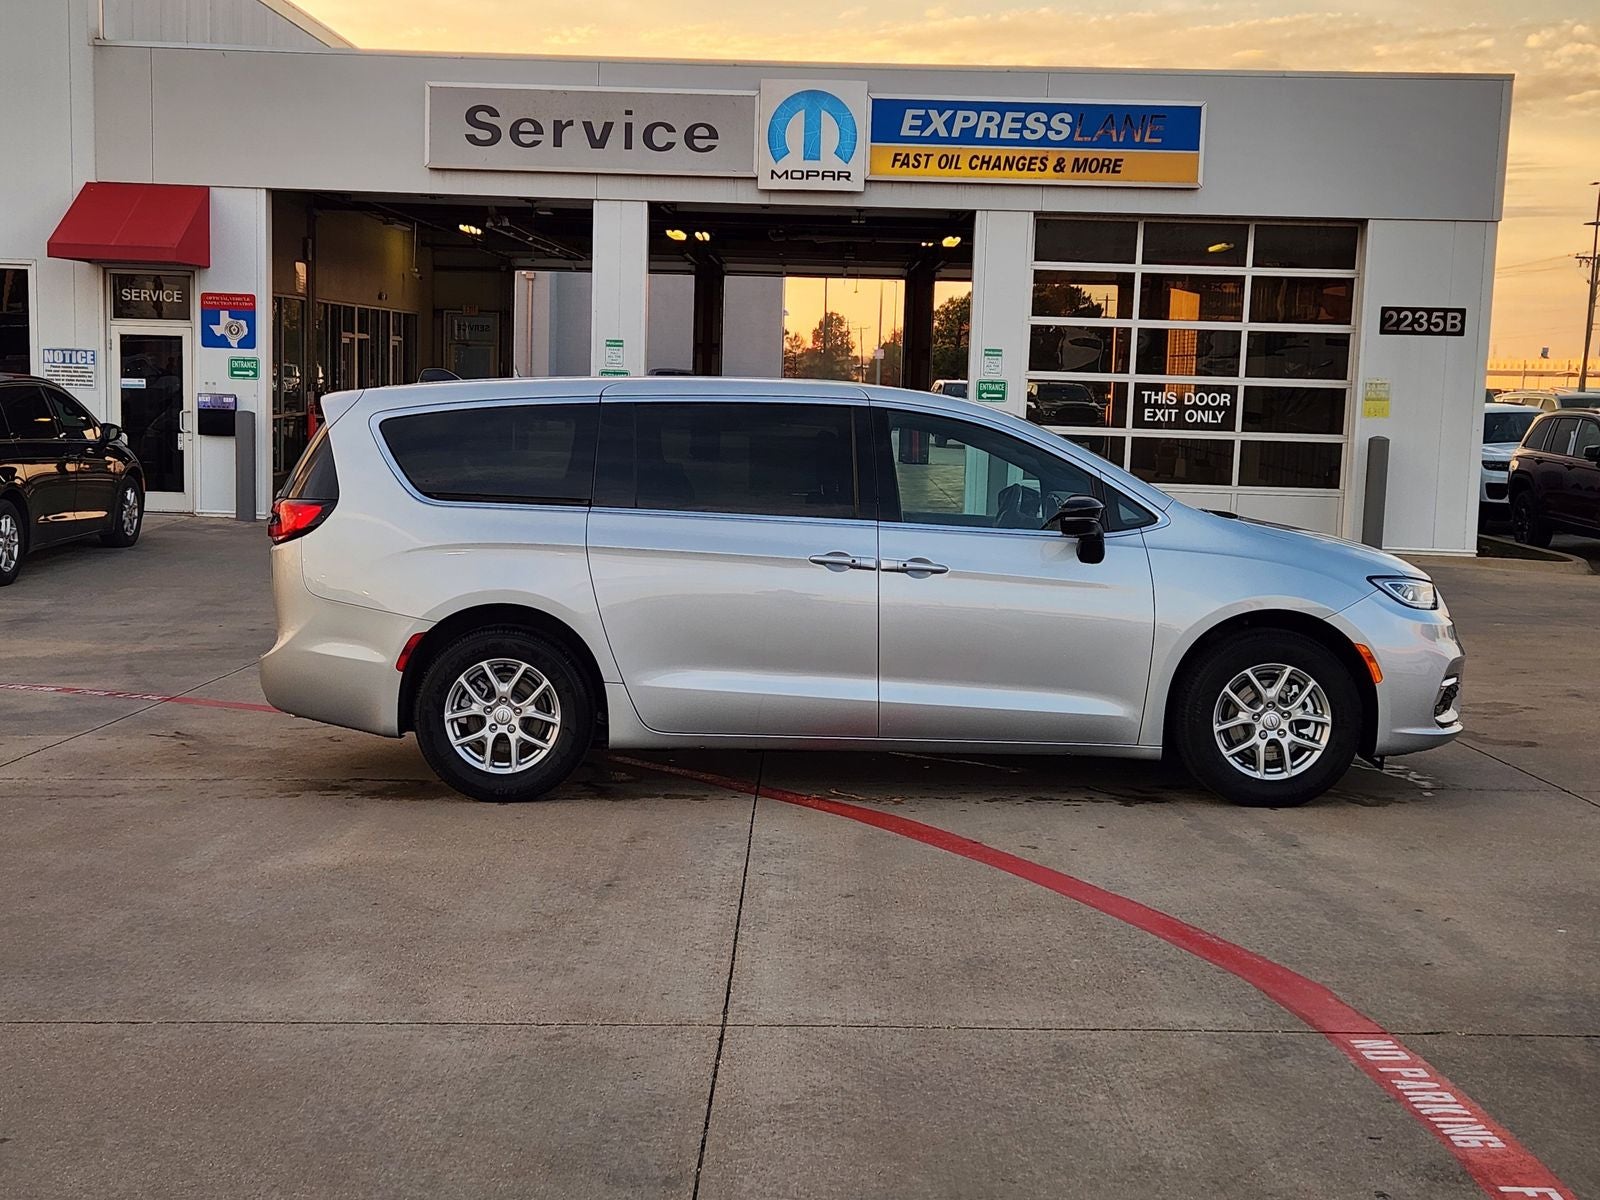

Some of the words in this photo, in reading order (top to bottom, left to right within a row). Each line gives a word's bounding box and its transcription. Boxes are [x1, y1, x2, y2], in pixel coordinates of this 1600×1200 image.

[464, 103, 719, 153] Service
[891, 152, 934, 169] FAST
[937, 153, 963, 170] OIL
[968, 154, 1049, 172] CHANGES
[1053, 157, 1066, 173] &
[1070, 157, 1124, 174] MORE
[770, 169, 852, 182] MOPAR
[121, 288, 183, 302] SERVICE
[1383, 310, 1462, 332] 2235B
[44, 349, 95, 364] NOTICE
[231, 360, 257, 369] ENTRANCE
[979, 383, 1005, 391] ENTRANCE
[1141, 390, 1177, 405] THIS
[1184, 392, 1231, 406] DOOR
[1143, 408, 1179, 422] EXIT
[1184, 409, 1226, 423] ONLY
[1350, 1039, 1411, 1061] NO
[1378, 1067, 1507, 1148] PARKING
